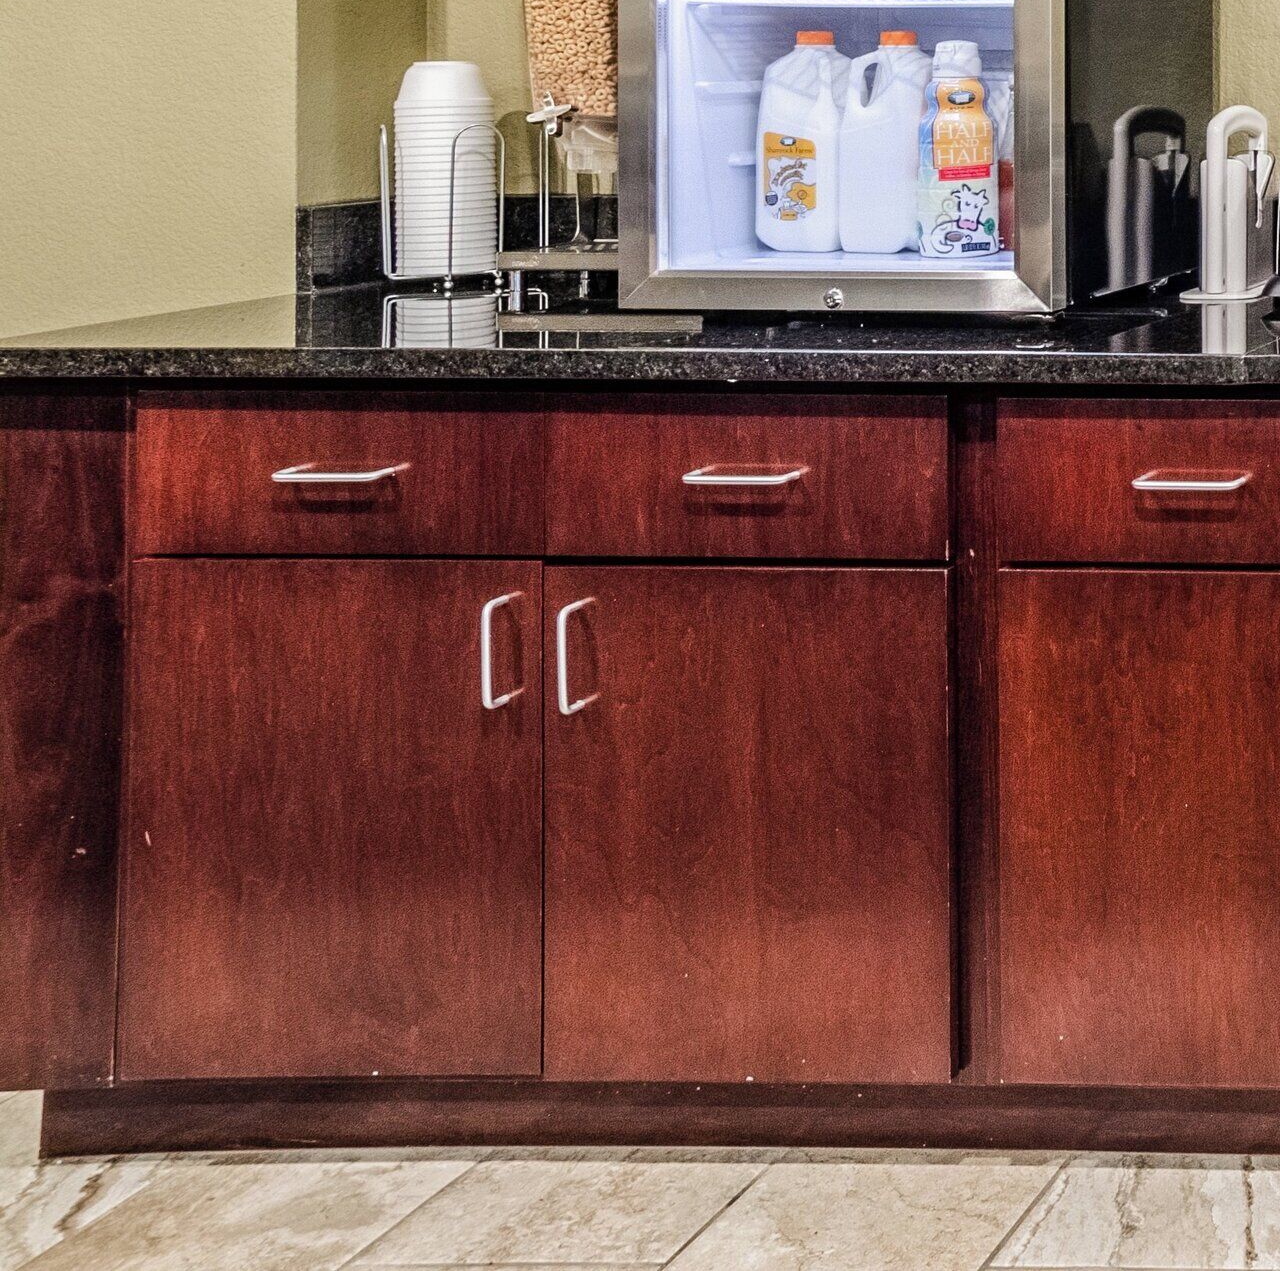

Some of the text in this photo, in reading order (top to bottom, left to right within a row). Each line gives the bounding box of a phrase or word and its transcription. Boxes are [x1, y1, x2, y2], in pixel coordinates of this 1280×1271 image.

[936, 120, 990, 140] HALF
[951, 138, 980, 148] AND
[936, 146, 992, 166] HALF
